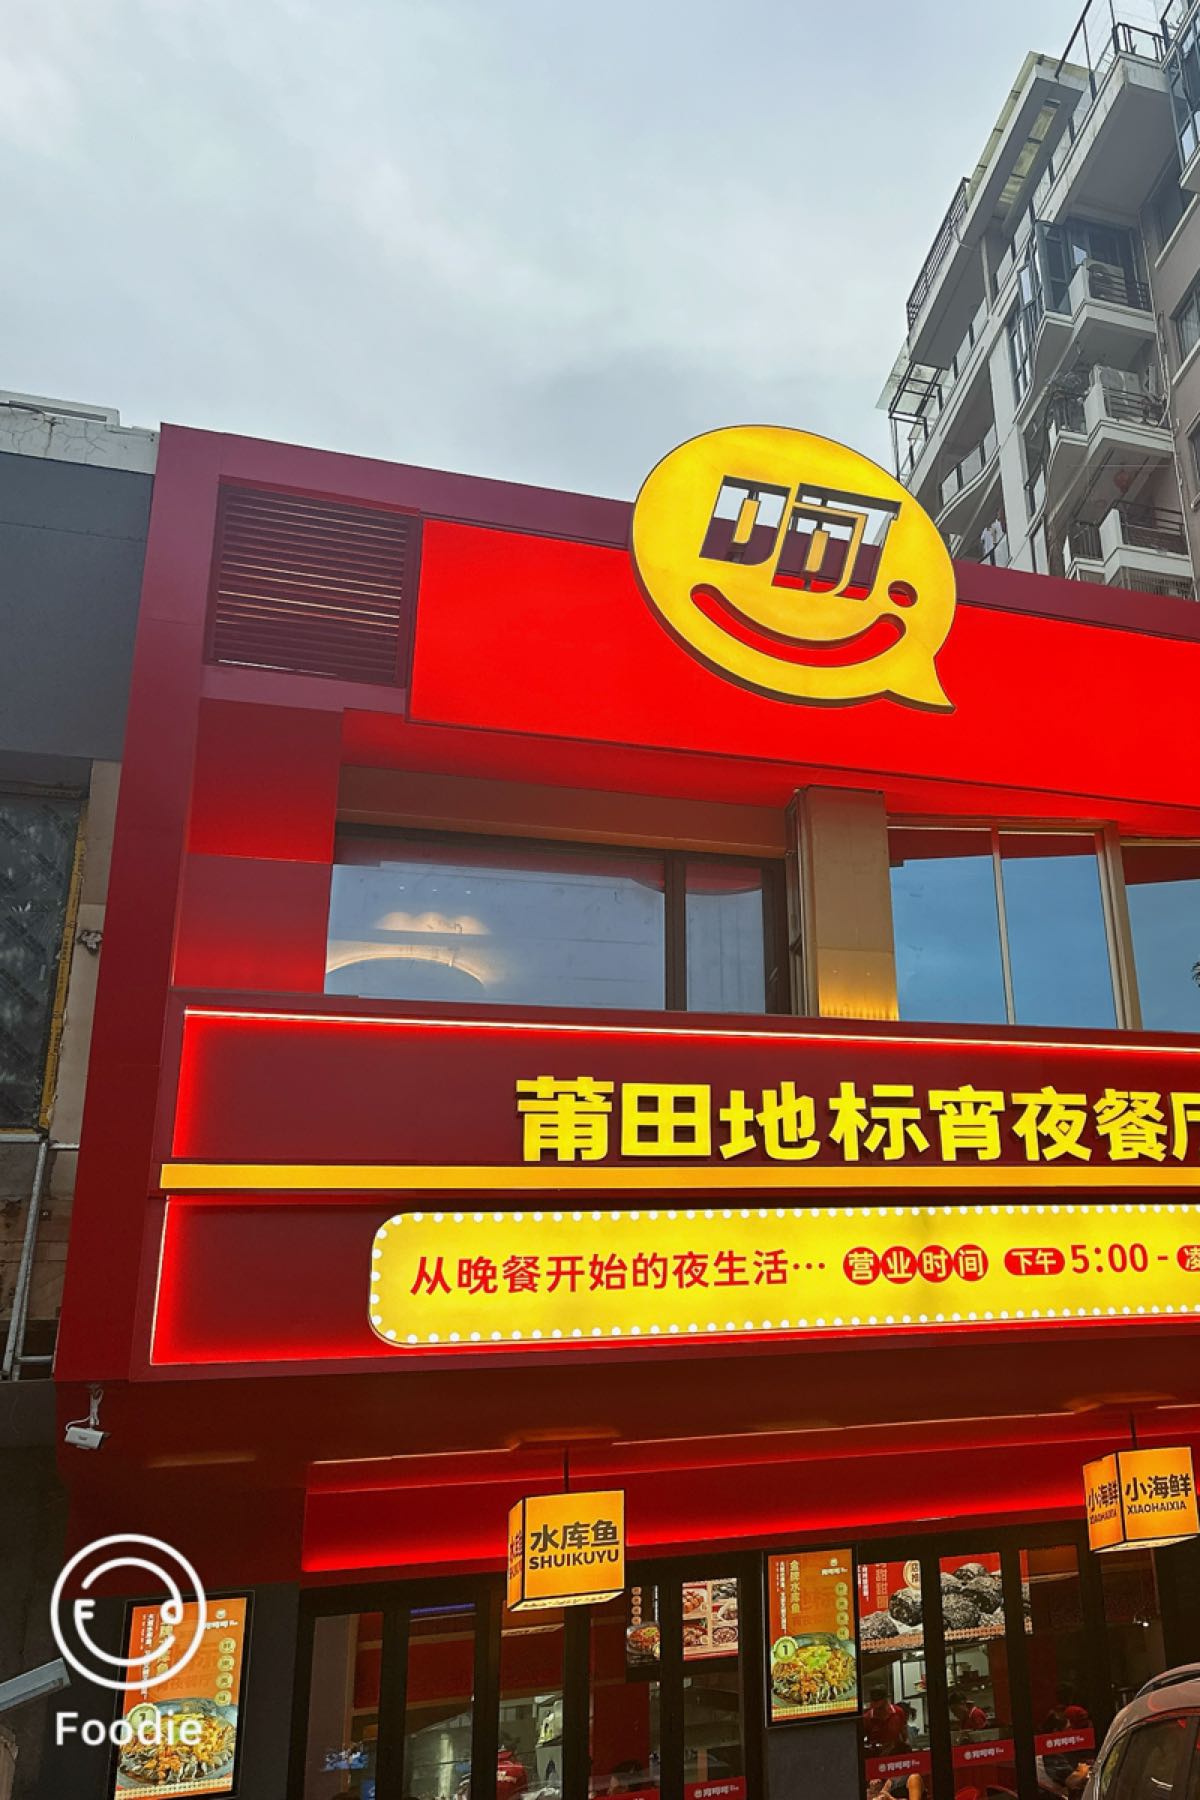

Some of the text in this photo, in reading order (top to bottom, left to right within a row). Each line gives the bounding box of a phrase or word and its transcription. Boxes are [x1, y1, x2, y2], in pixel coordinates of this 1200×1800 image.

[844, 1246, 988, 1284] 营业时间
[1010, 1249, 1059, 1275] 下午
[1088, 1480, 1119, 1512] 小海鲜
[1125, 1473, 1192, 1502] 小海鲜
[1127, 1500, 1187, 1515] XIAOHAIXIA
[530, 1519, 619, 1553] 水库鱼
[528, 1549, 620, 1571] SHUIKUYU
